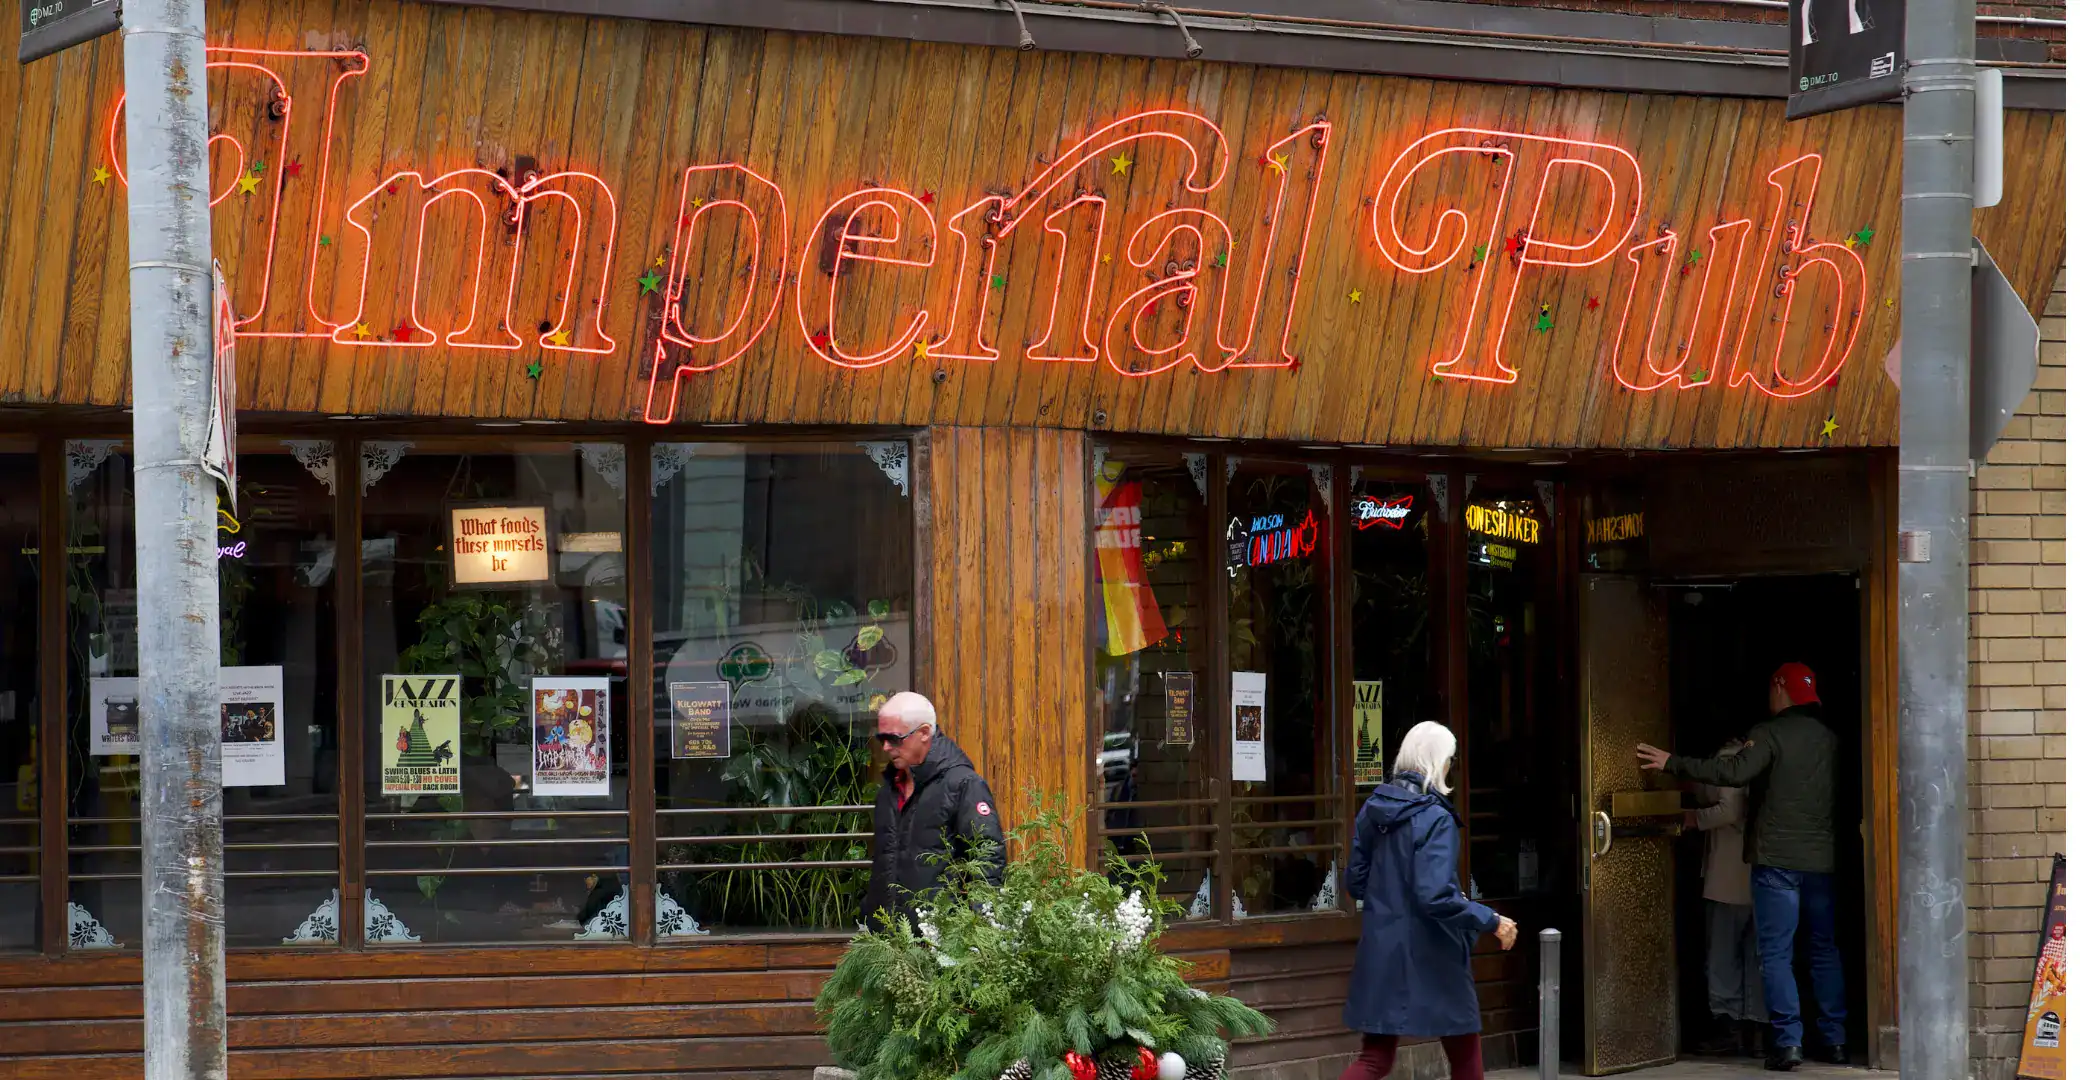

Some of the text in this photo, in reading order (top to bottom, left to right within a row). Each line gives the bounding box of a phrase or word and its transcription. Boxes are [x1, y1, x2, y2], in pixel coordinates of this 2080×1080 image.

[1810, 72, 1839, 86] DMZ.TO
[110, 48, 1867, 425] Imperial Pub
[460, 516, 540, 536] What foods
[1250, 513, 1284, 532] MOLSON
[1465, 504, 1539, 544] ONESHAKER
[216, 541, 246, 559] yal
[454, 535, 544, 554] these morsels
[1247, 527, 1300, 568] CANADIAN
[492, 555, 508, 572] be
[385, 679, 457, 706] JAZZ
[676, 700, 722, 708] KILOWATT
[688, 708, 712, 716] BAND
[126, 734, 140, 743] GROU
